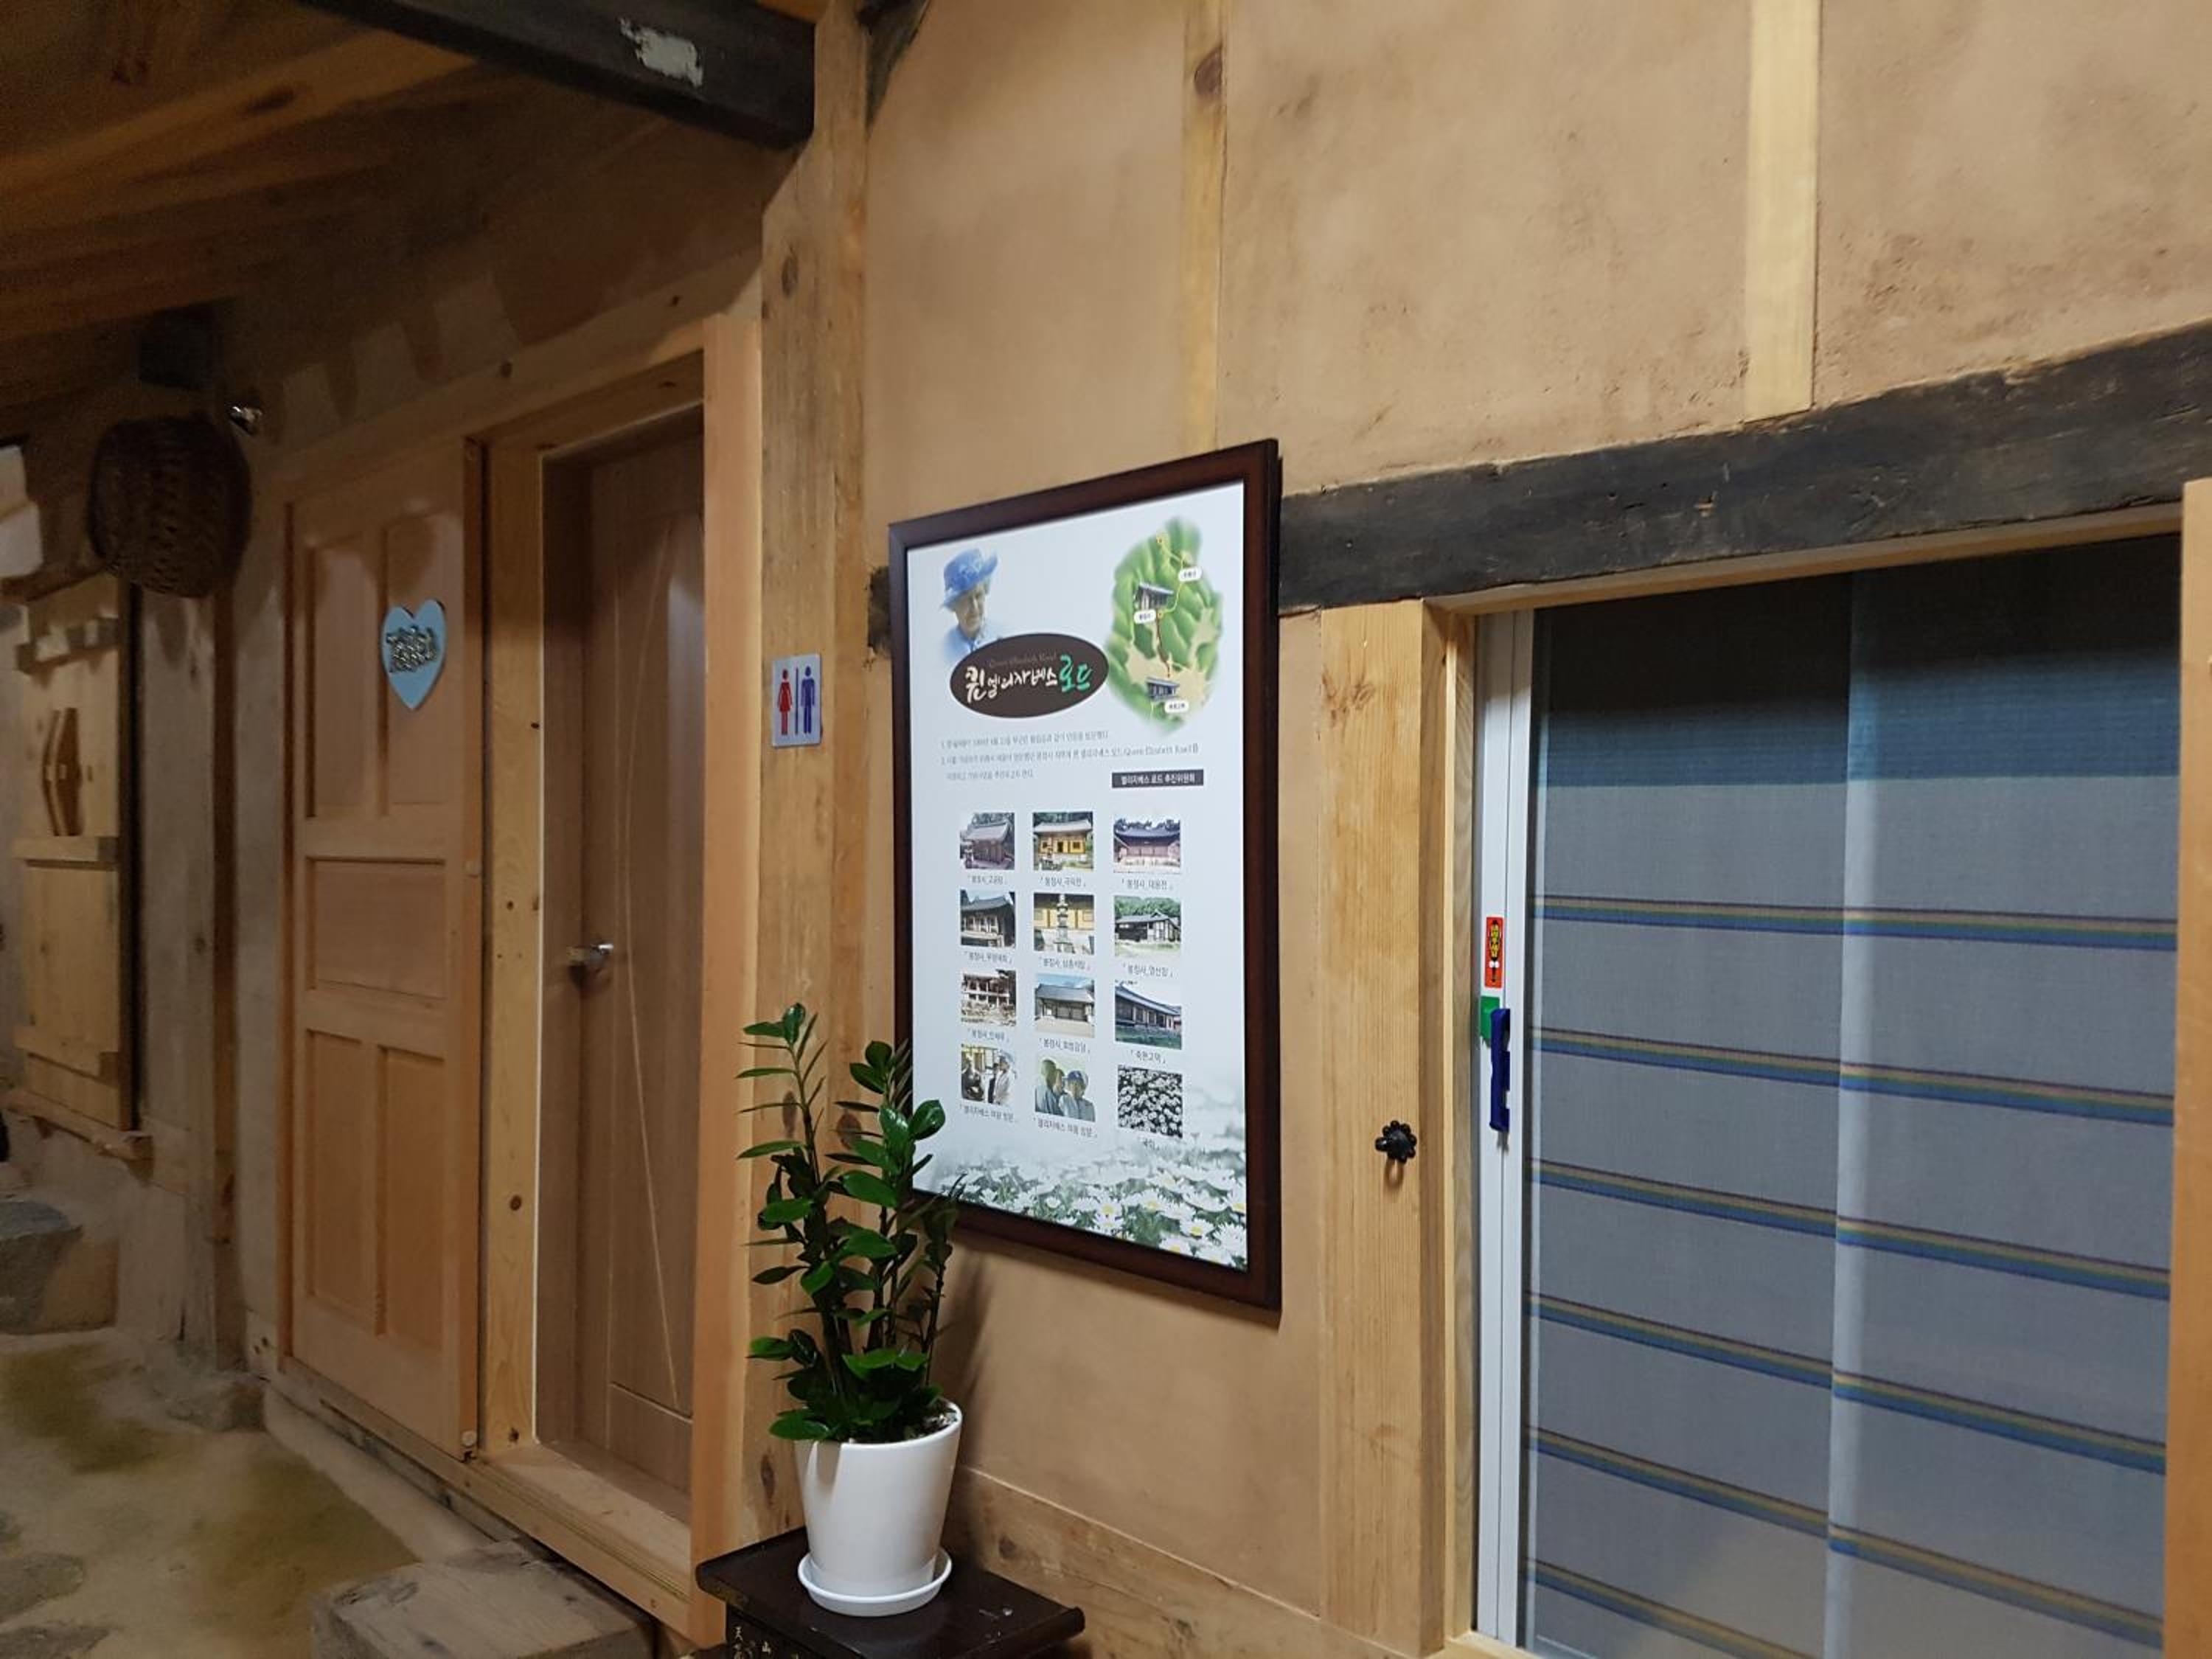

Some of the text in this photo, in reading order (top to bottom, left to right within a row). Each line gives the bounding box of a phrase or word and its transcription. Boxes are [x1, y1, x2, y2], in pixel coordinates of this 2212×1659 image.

[964, 654, 1091, 703] 퀸 엘리자베스 로드
